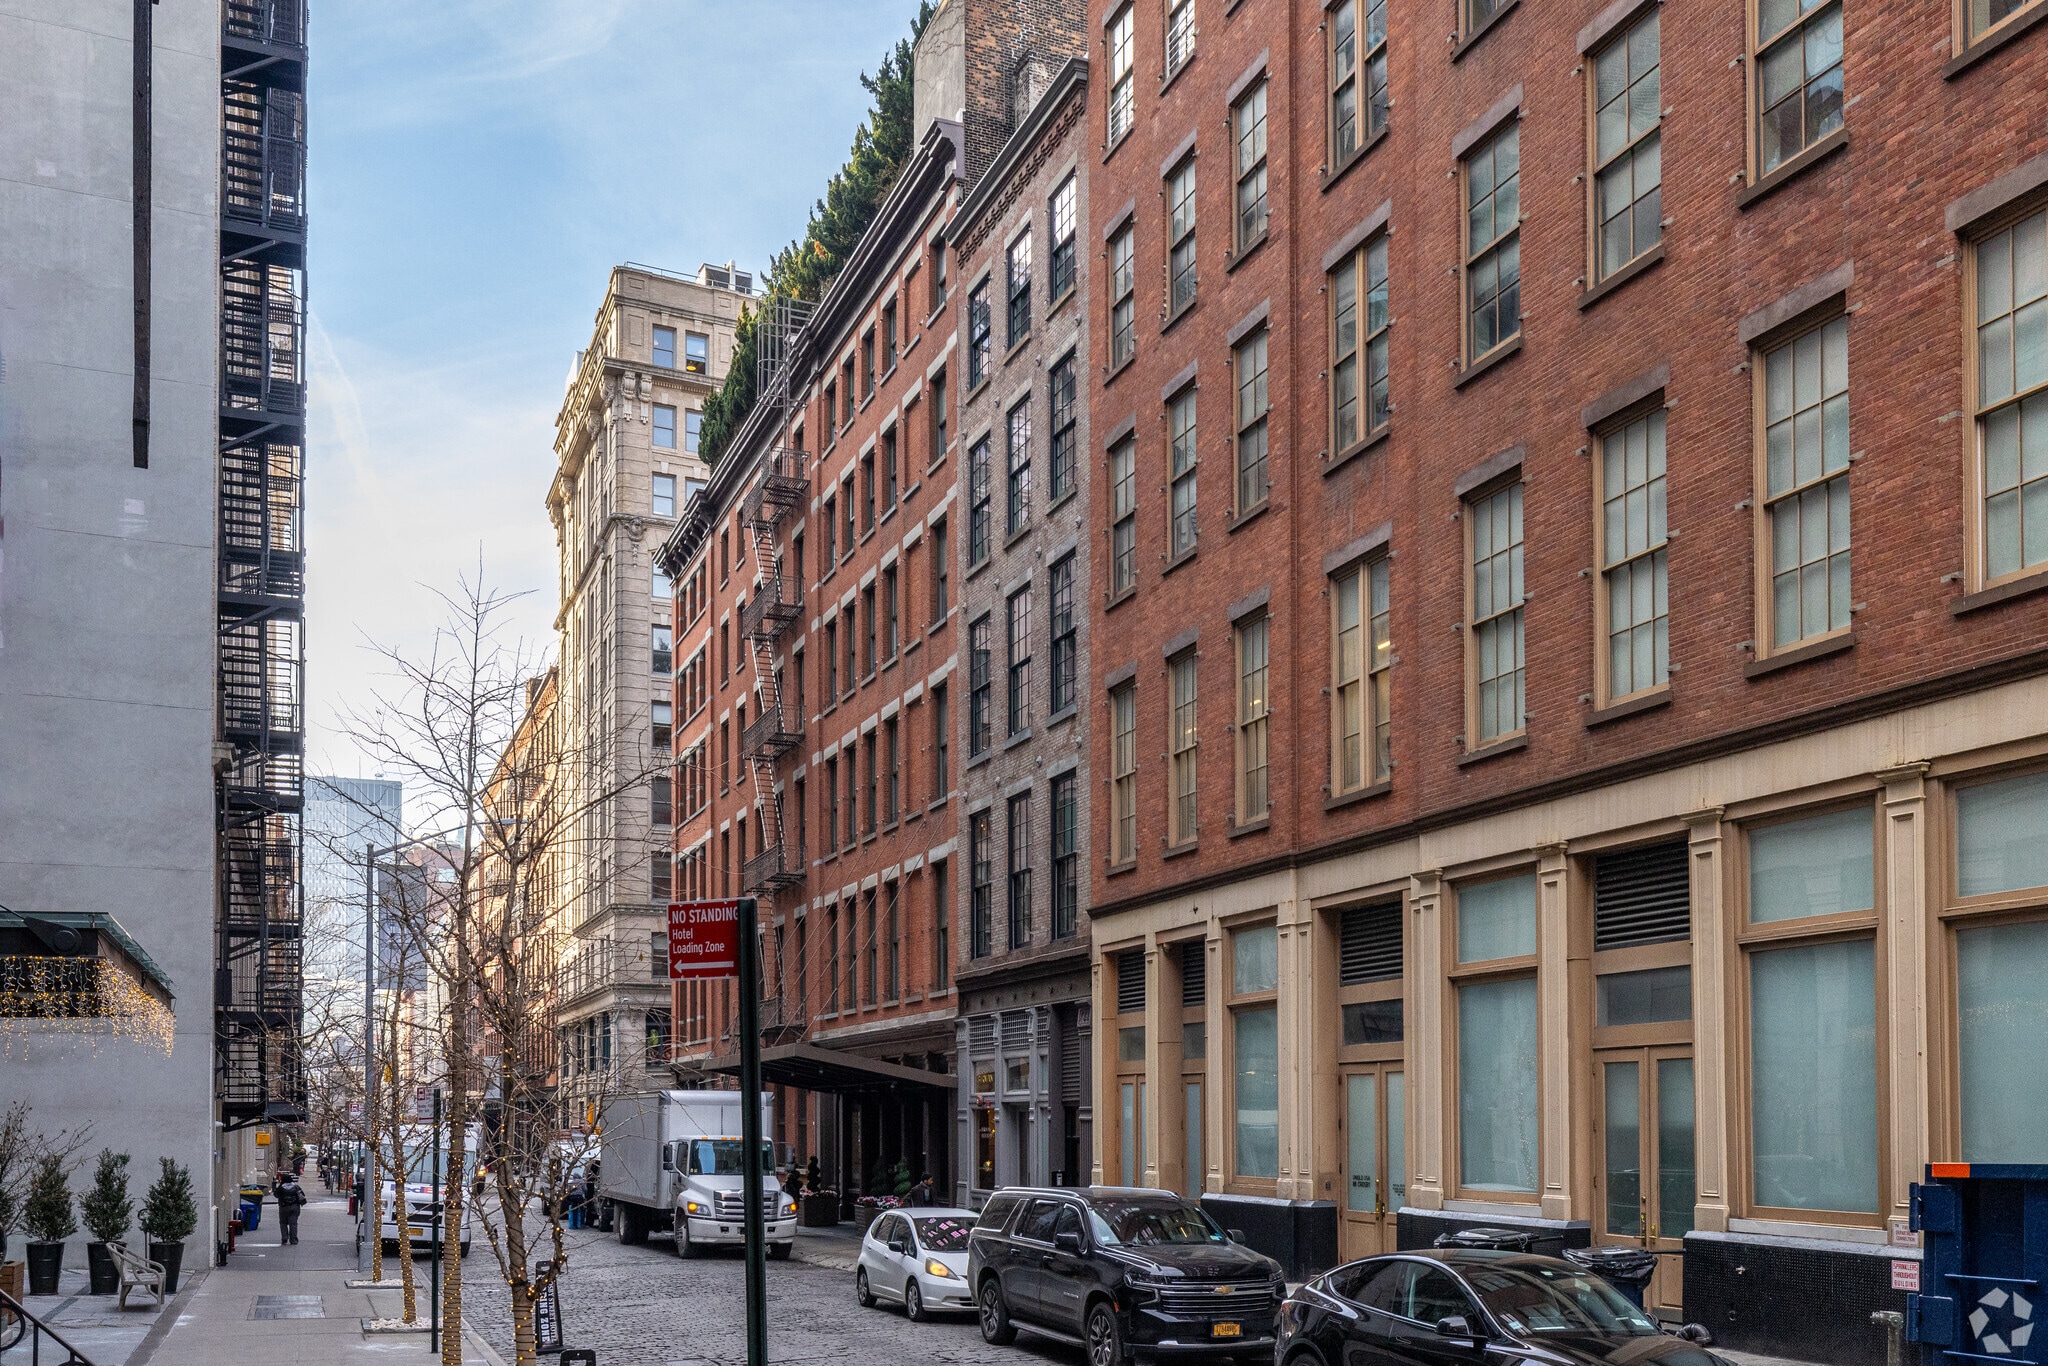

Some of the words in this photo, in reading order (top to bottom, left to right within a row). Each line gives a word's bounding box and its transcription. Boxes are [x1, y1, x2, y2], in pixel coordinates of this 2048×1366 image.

[672, 910, 686, 924] NO
[672, 928, 693, 940] Hotel
[673, 941, 703, 955] Loading
[705, 941, 725, 953] Zone
[1893, 1263, 1918, 1271] SPRINKLERS
[1894, 1280, 1917, 1288] BUILDING
[548, 1298, 556, 1321] STREET
[540, 1318, 551, 1343] ZONE
[549, 1321, 557, 1343] HOTEL
